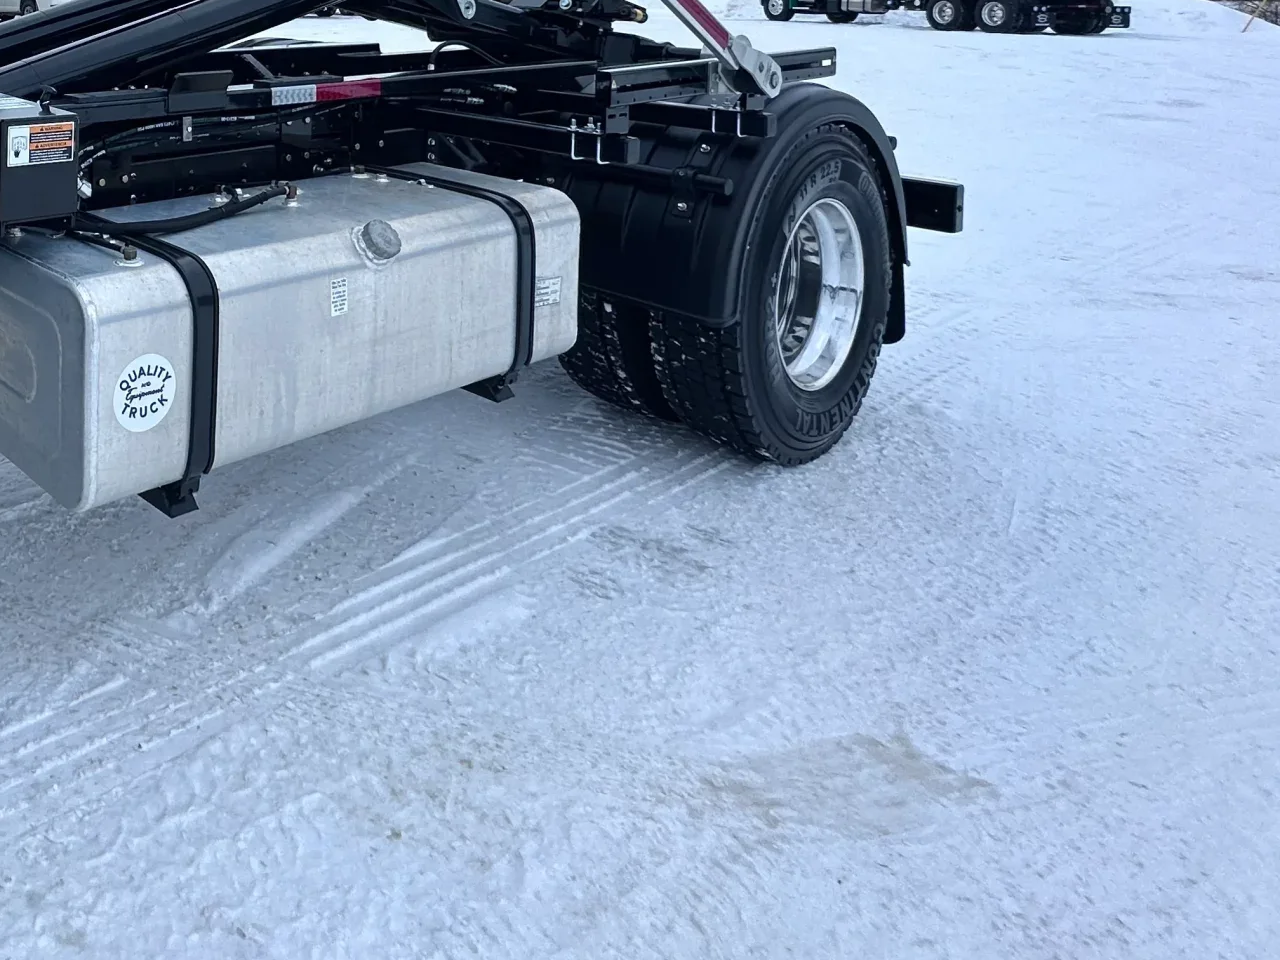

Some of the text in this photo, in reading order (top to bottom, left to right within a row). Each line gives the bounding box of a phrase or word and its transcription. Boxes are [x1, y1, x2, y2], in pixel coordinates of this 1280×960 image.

[119, 364, 173, 392] QUALITY
[795, 321, 885, 438] CONTINENTAL
[121, 393, 169, 419] TRUCK
